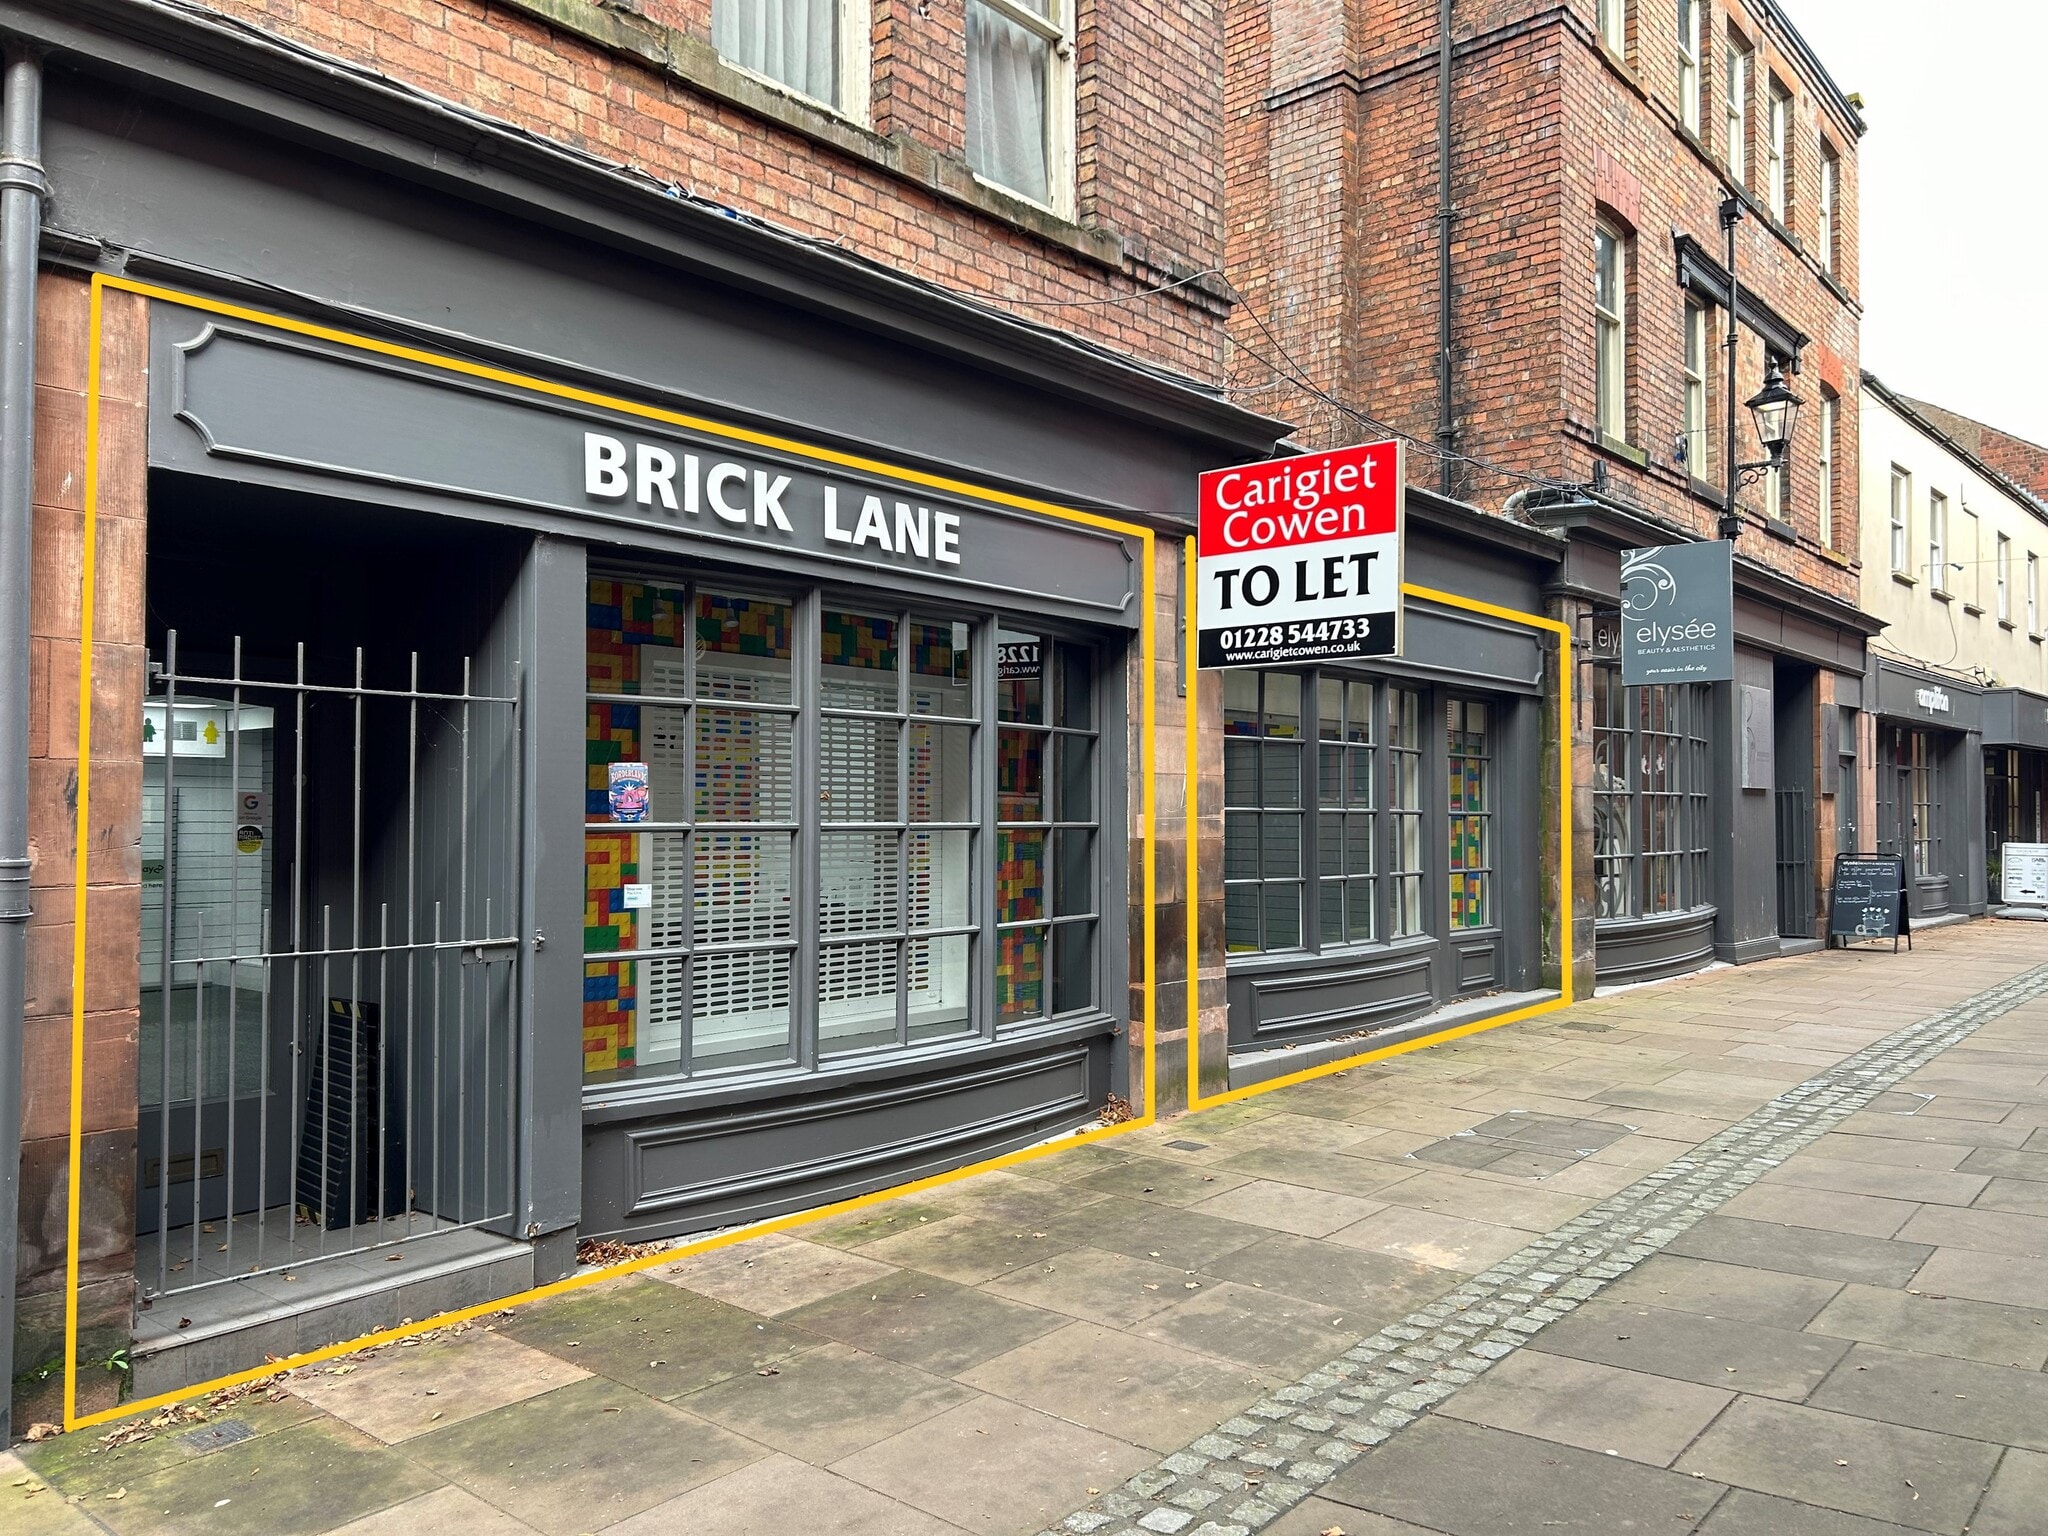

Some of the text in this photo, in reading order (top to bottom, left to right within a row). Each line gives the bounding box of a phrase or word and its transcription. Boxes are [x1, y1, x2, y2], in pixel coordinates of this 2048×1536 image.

[1216, 454, 1378, 511] Carigiet
[584, 432, 961, 565] BRICK LANE
[1223, 503, 1367, 548] Cowen
[1213, 551, 1379, 610] TO LET
[1220, 618, 1370, 650] 01228 544733
[1598, 624, 1621, 655] ely
[1636, 618, 1716, 646] elysée
[1226, 641, 1361, 662] www.carigietcowen.co.uk
[1637, 647, 1664, 655] BEAUTY
[1672, 644, 1716, 653] AESTHETICS
[1695, 664, 1707, 672] city
